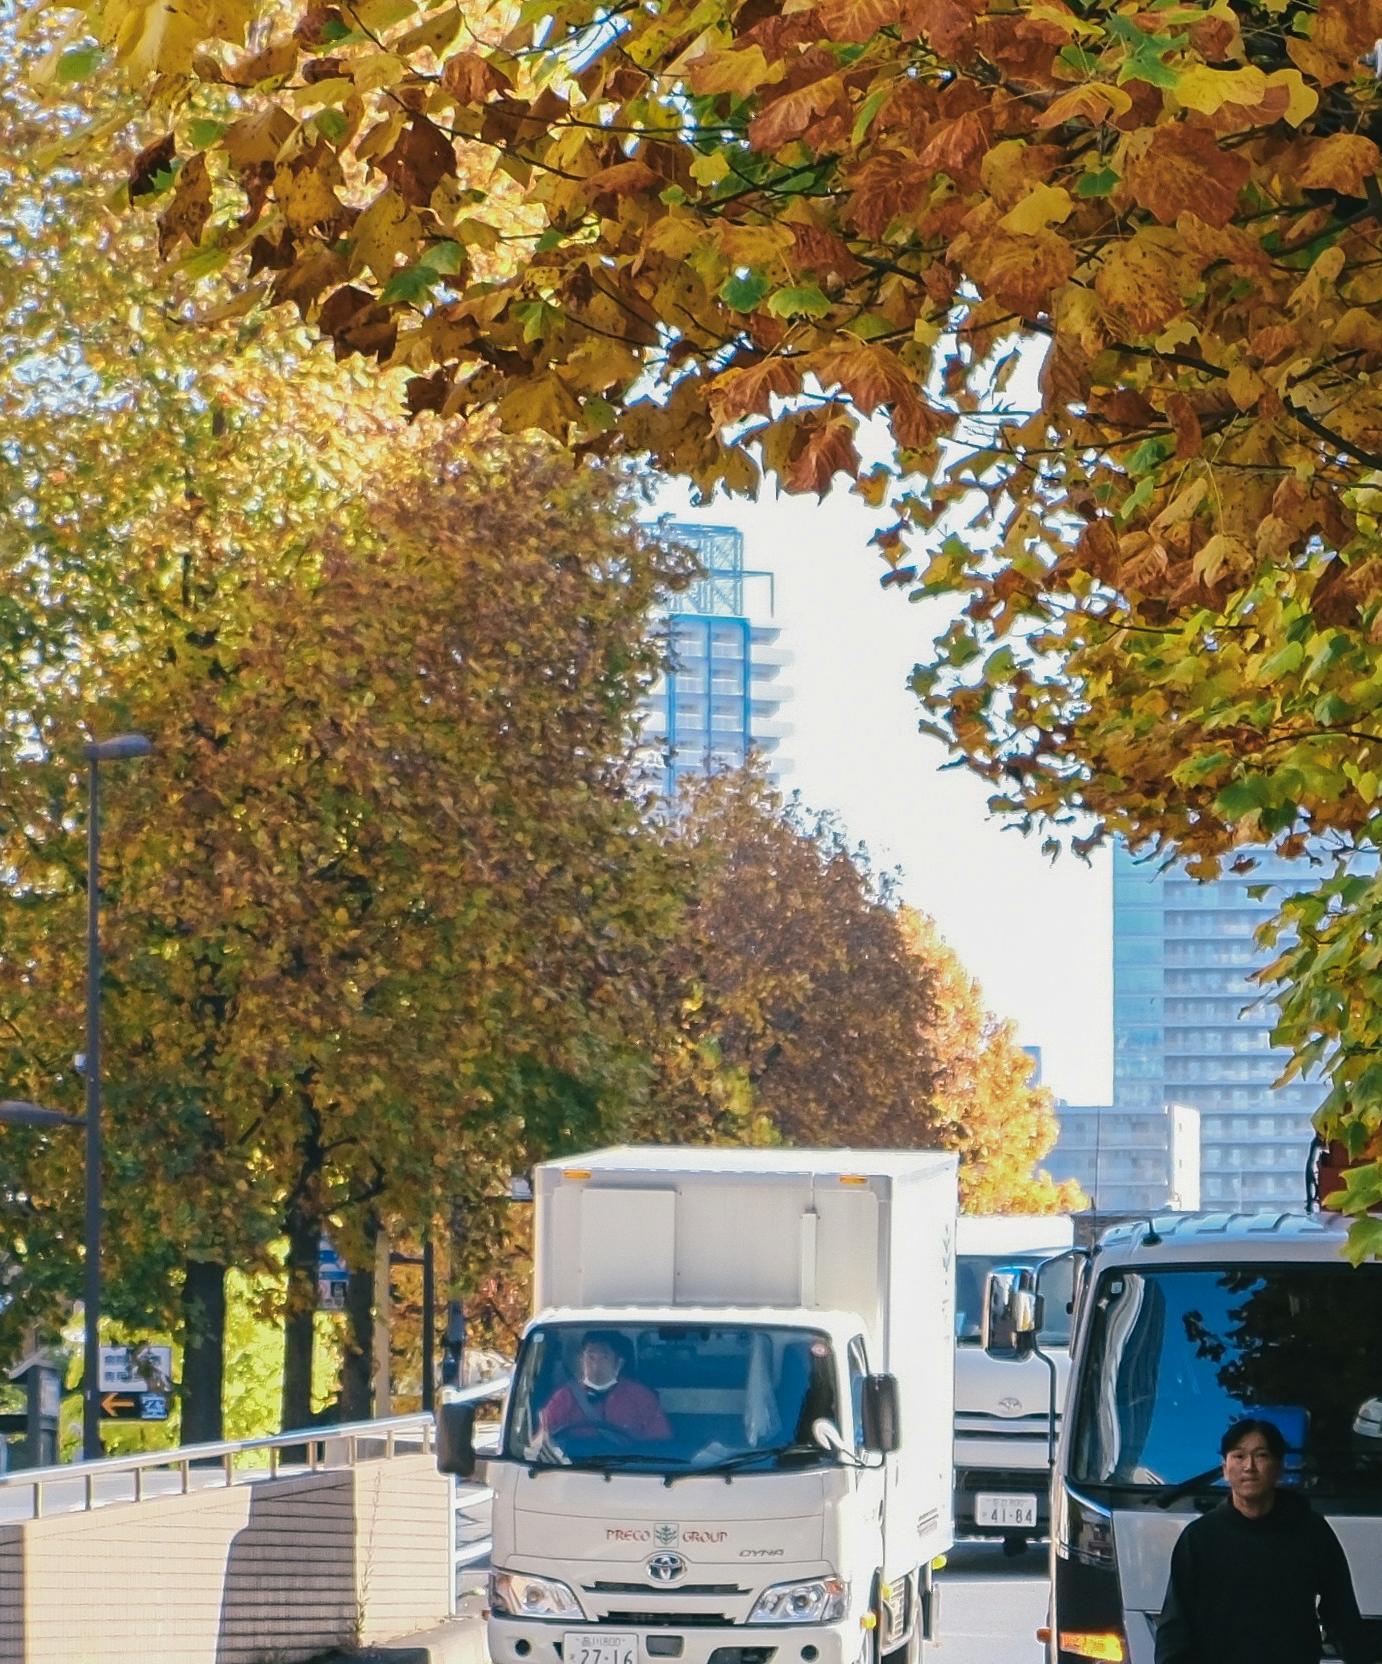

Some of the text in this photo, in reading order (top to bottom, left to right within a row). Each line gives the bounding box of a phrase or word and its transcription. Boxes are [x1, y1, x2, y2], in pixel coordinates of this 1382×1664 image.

[991, 1508, 1033, 1523] 41-84
[606, 1529, 728, 1543] PRECO GROUP
[739, 1549, 785, 1557] DYNA
